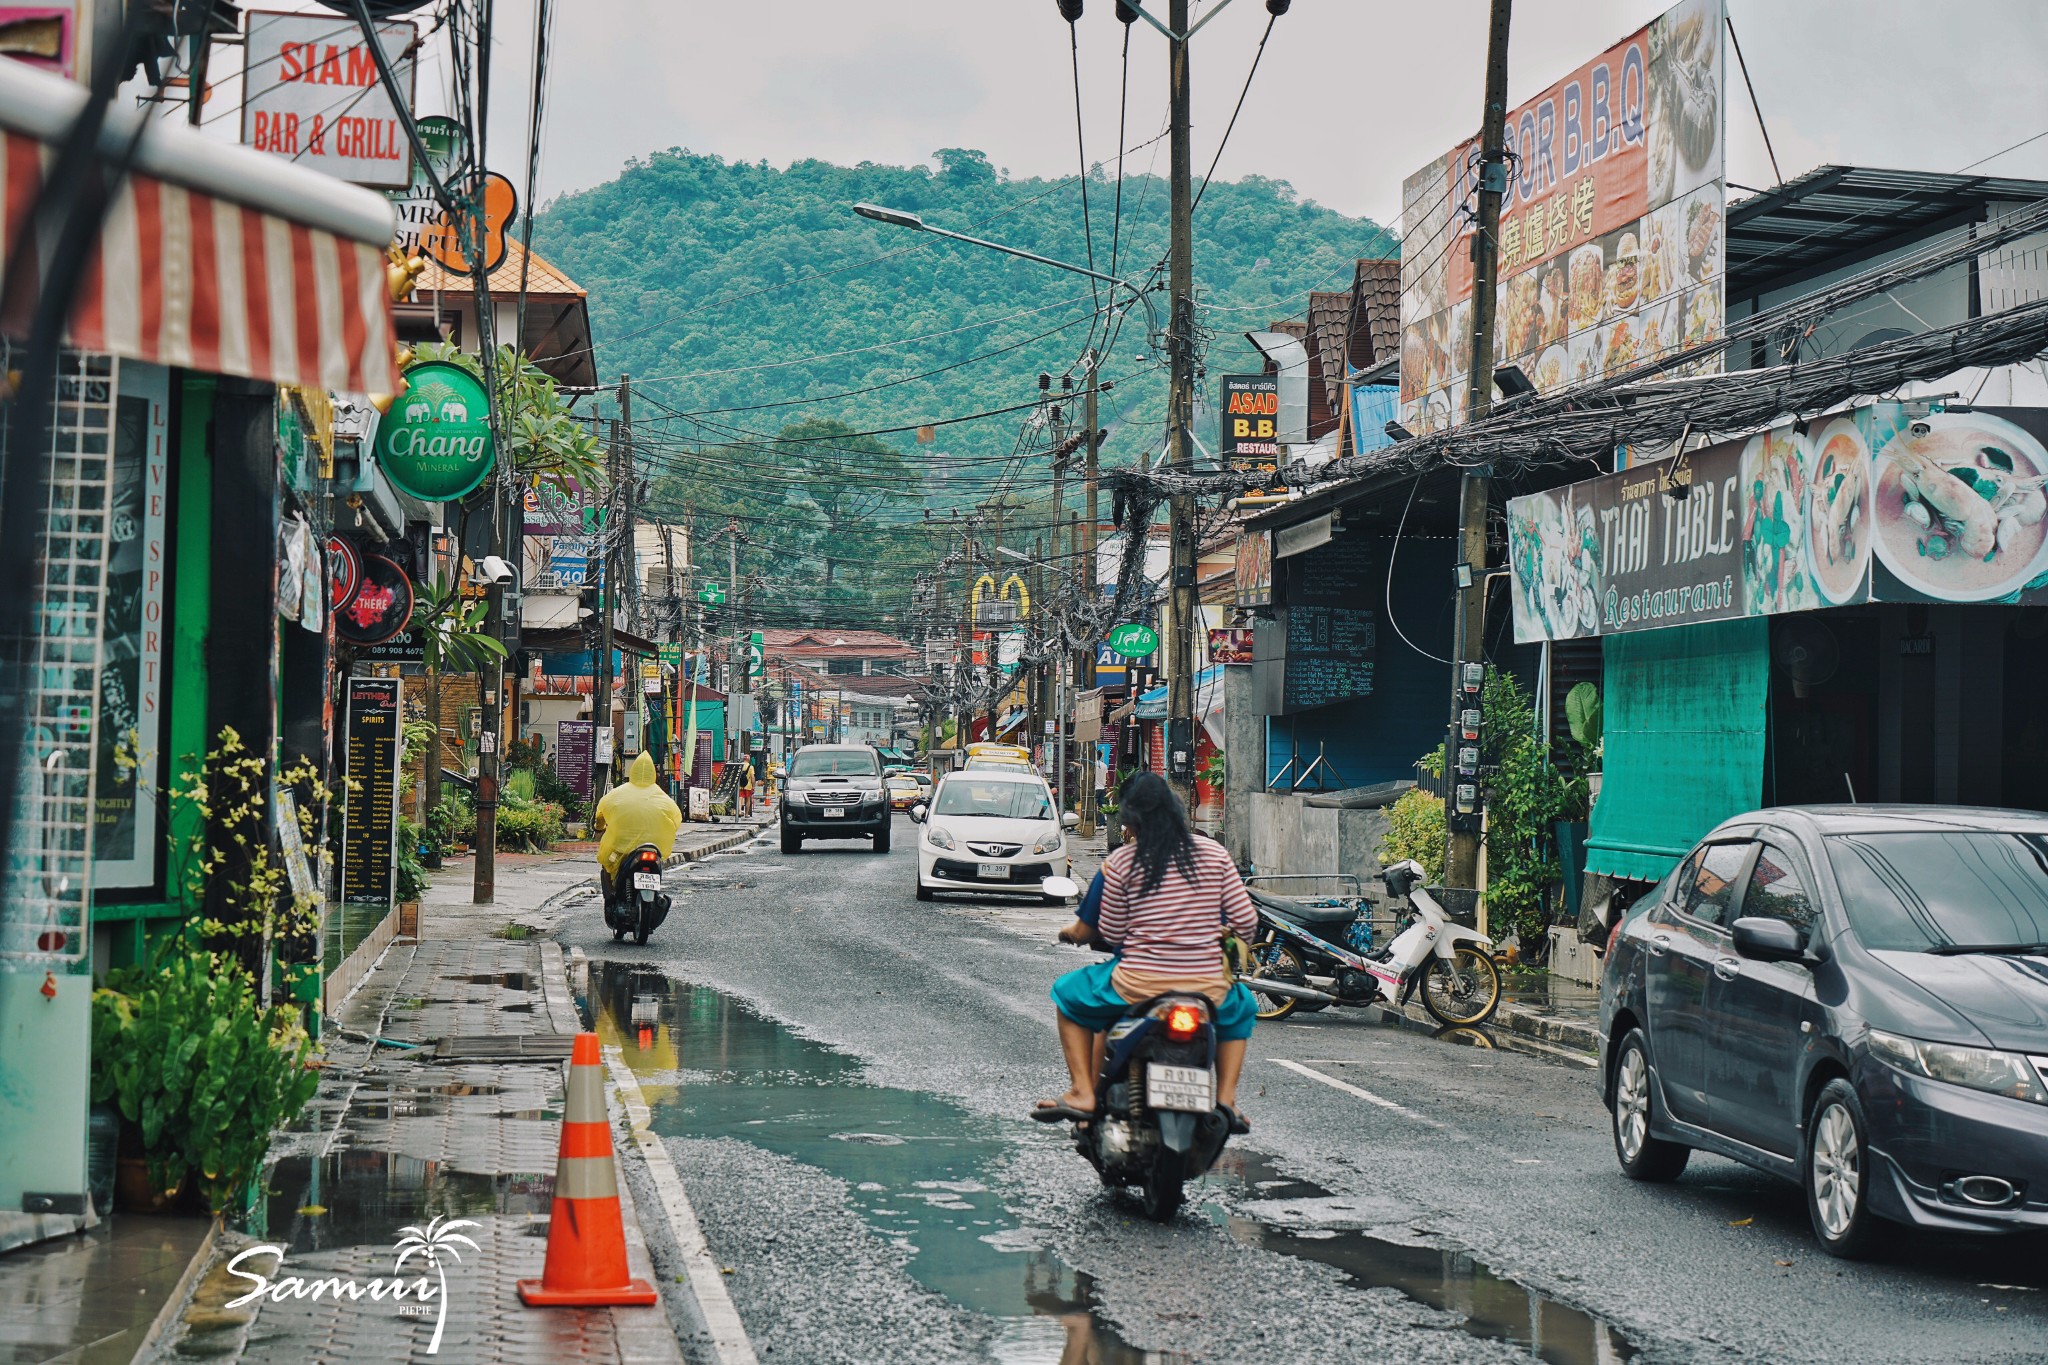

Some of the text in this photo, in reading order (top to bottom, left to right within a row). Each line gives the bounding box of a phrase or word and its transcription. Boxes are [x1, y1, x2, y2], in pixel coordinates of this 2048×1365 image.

[279, 41, 377, 88] SIAM
[254, 110, 400, 160] BAR & GRILL
[1563, 42, 1645, 180] B.B.Q
[387, 427, 486, 462] Chang
[1600, 475, 1737, 577] THAI TABLE
[1603, 574, 1733, 629] Restaurant
[372, 647, 387, 655] 089
[389, 647, 403, 655] 908
